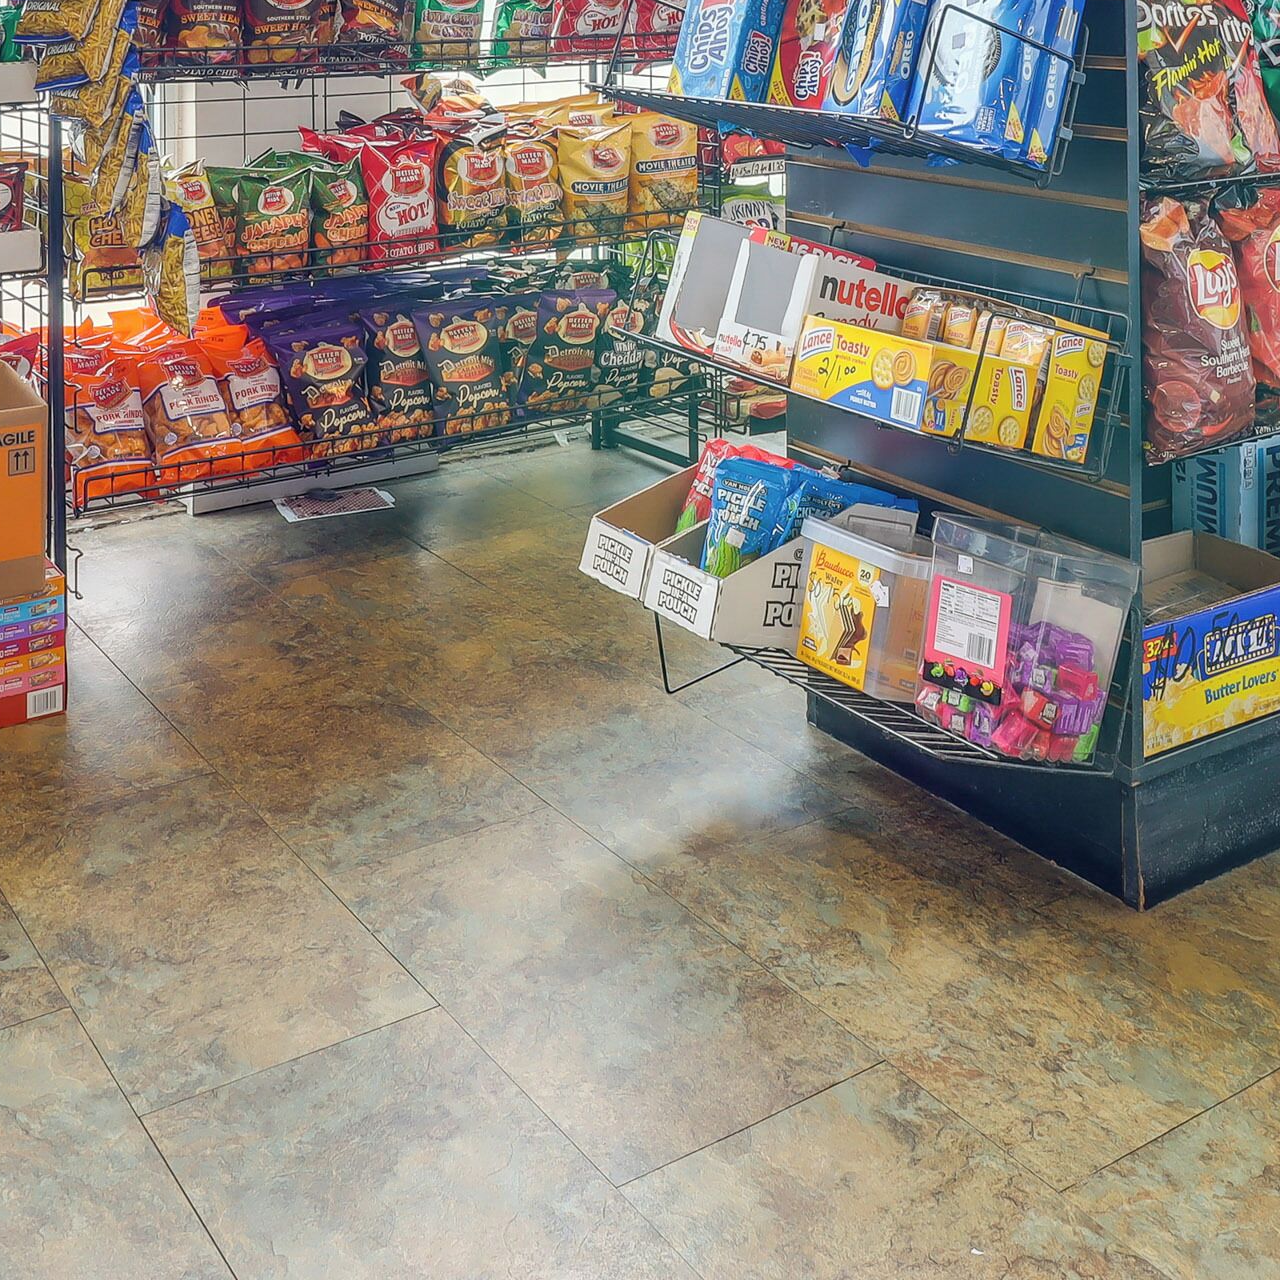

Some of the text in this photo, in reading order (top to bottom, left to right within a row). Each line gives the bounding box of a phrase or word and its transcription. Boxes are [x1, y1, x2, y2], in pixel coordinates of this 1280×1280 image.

[27, 0, 61, 11] ORIGINAL
[181, 13, 217, 24] SWEET
[691, 9, 717, 70] Chips
[745, 32, 772, 74] Chips Ahoy!
[902, 30, 914, 79] OREO
[795, 52, 823, 99] Chips Ahoy!
[638, 156, 696, 172] MOVIE THEATER
[396, 199, 430, 227] HOT!
[767, 235, 787, 246] NEW
[1194, 257, 1240, 314] Lay's
[802, 331, 870, 357] Lance Toasty
[1057, 337, 1084, 349] Lance
[1055, 364, 1079, 379] Toasty
[234, 389, 259, 400] PORK
[990, 367, 1003, 406] Toasty
[1014, 369, 1024, 408] Lance
[598, 534, 633, 564] PICKLE
[593, 556, 628, 585] POUCH
[815, 551, 871, 580] Bauducco 20
[824, 572, 844, 587] Wafer
[662, 569, 702, 601] PICKLE
[658, 592, 697, 624] POUCH
[1204, 670, 1277, 705] Butter Lovers
